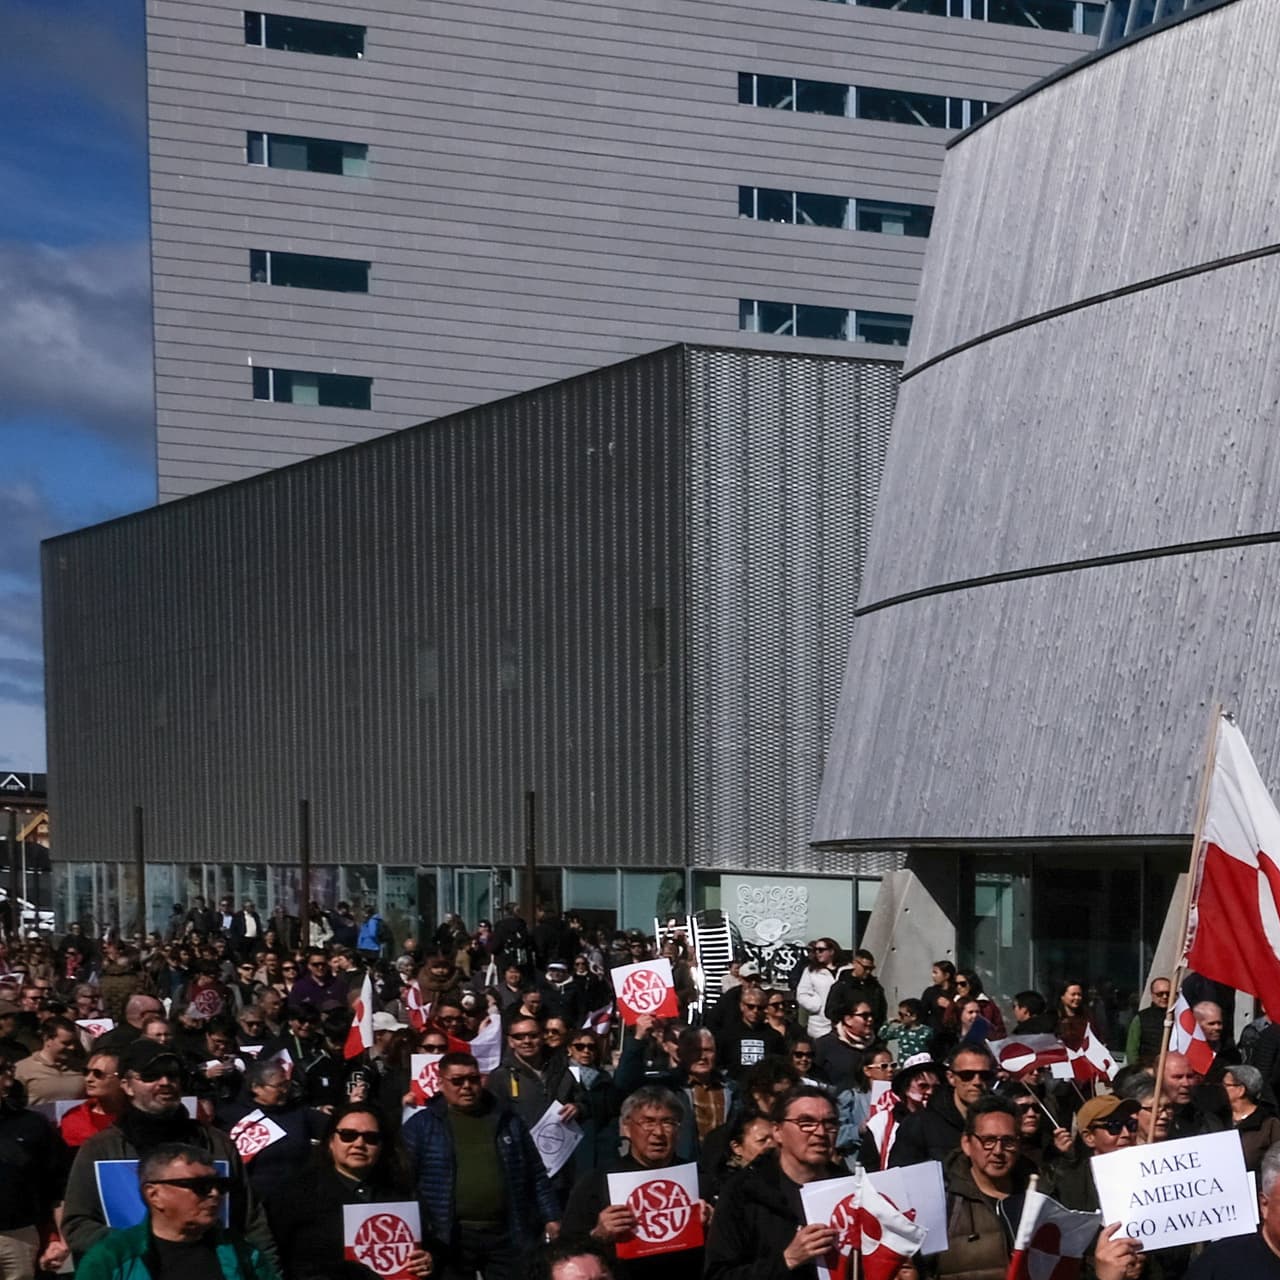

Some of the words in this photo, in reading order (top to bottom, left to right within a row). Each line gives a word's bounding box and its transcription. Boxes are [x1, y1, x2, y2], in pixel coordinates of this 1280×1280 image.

[624, 971, 664, 994] USA
[627, 988, 663, 1010] ASU
[1139, 1151, 1201, 1178] MAKE
[630, 1181, 688, 1218] USA
[1129, 1177, 1224, 1209] AMERICA
[360, 1215, 413, 1245] USA
[1126, 1218, 1156, 1239] GO
[1164, 1204, 1237, 1233] AWAY!!
[360, 1243, 410, 1272] ASU
